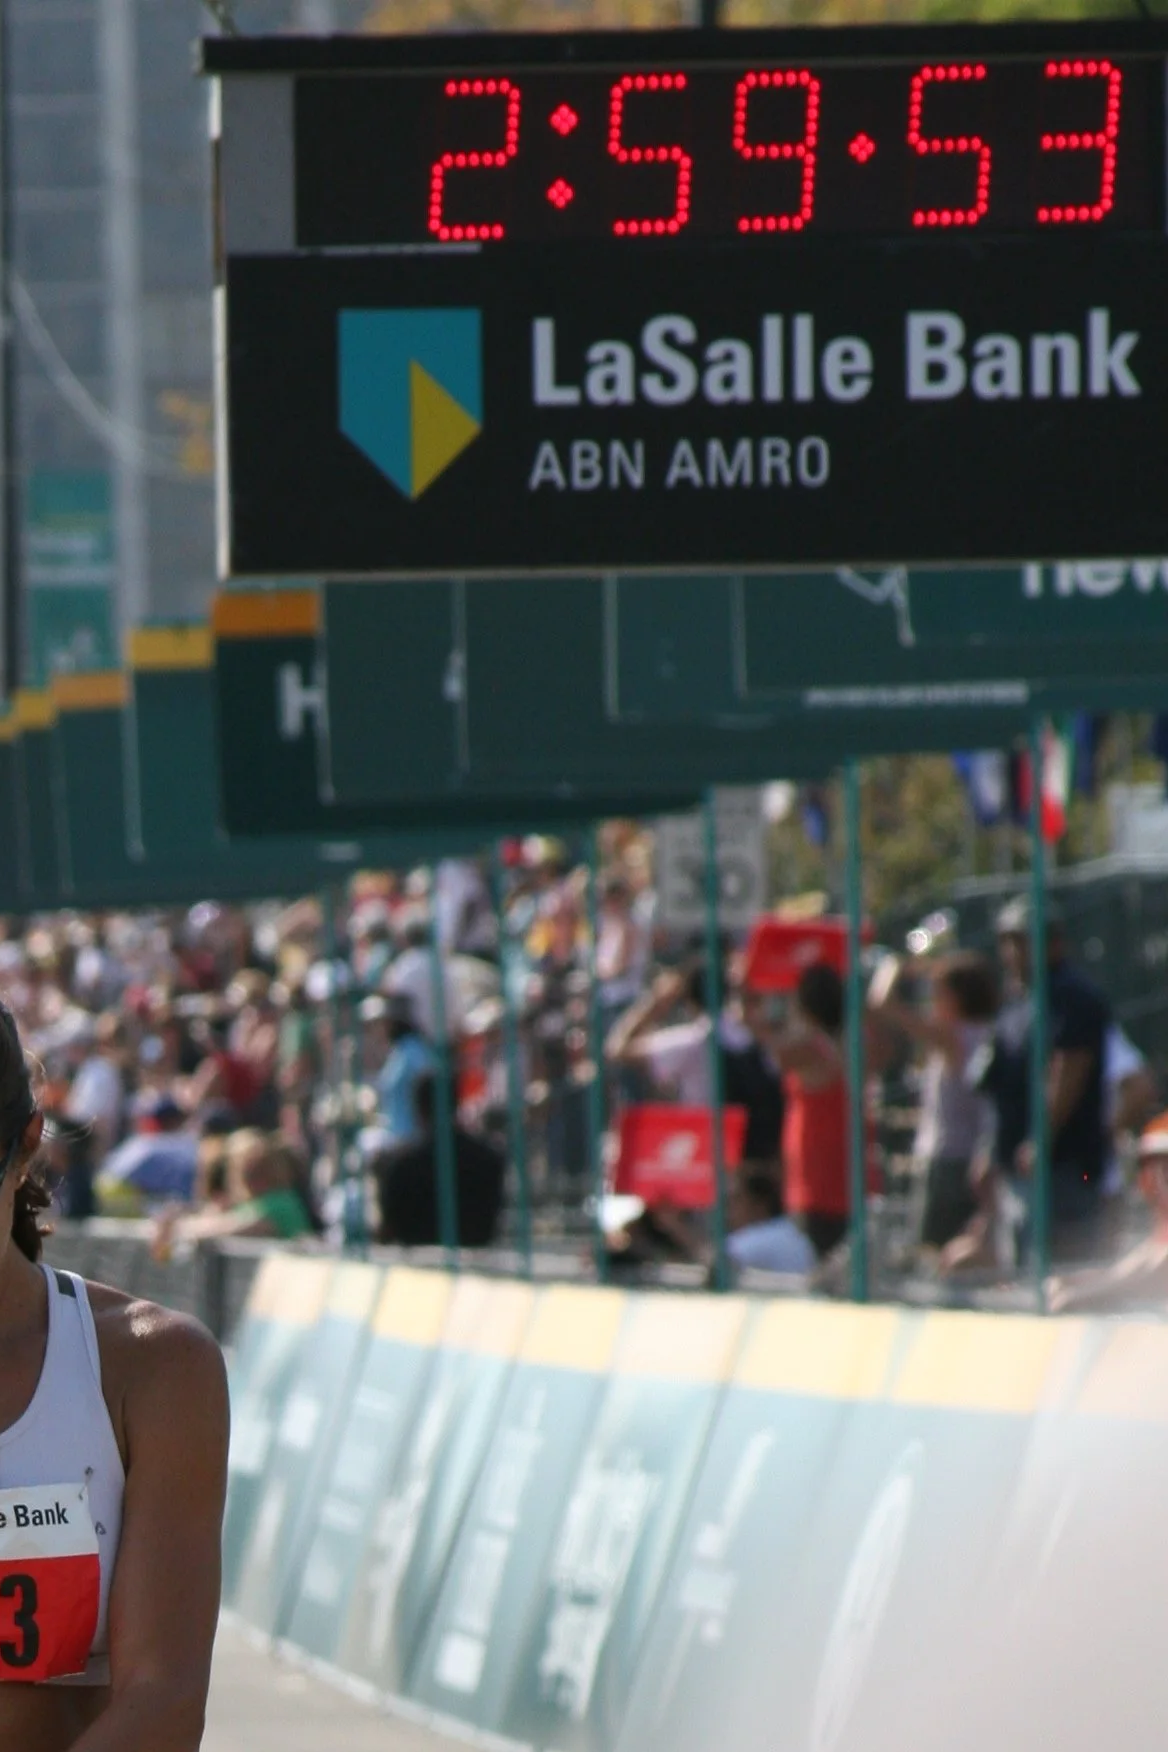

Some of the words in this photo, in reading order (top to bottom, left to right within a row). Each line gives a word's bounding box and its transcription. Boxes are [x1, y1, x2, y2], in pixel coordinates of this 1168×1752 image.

[531, 312, 873, 407] LaSalle
[905, 307, 1141, 402] Bank
[528, 438, 646, 491] ABN
[664, 435, 831, 488] AMRO
[13, 1501, 70, 1528] Bank
